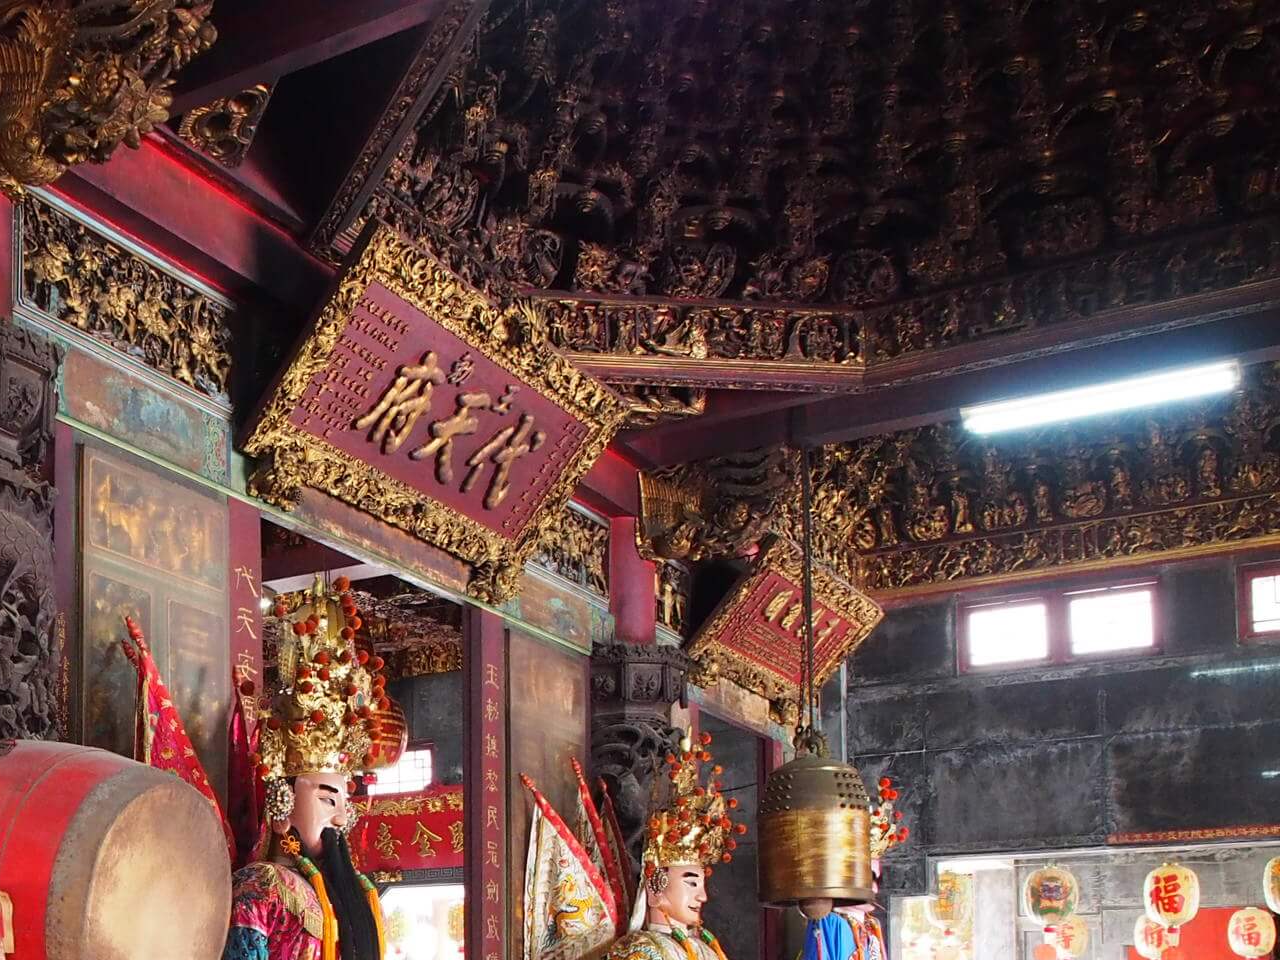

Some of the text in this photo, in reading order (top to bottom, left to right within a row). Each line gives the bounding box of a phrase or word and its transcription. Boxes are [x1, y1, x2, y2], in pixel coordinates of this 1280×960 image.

[350, 349, 547, 511] 代天府
[1150, 874, 1185, 914] 福
